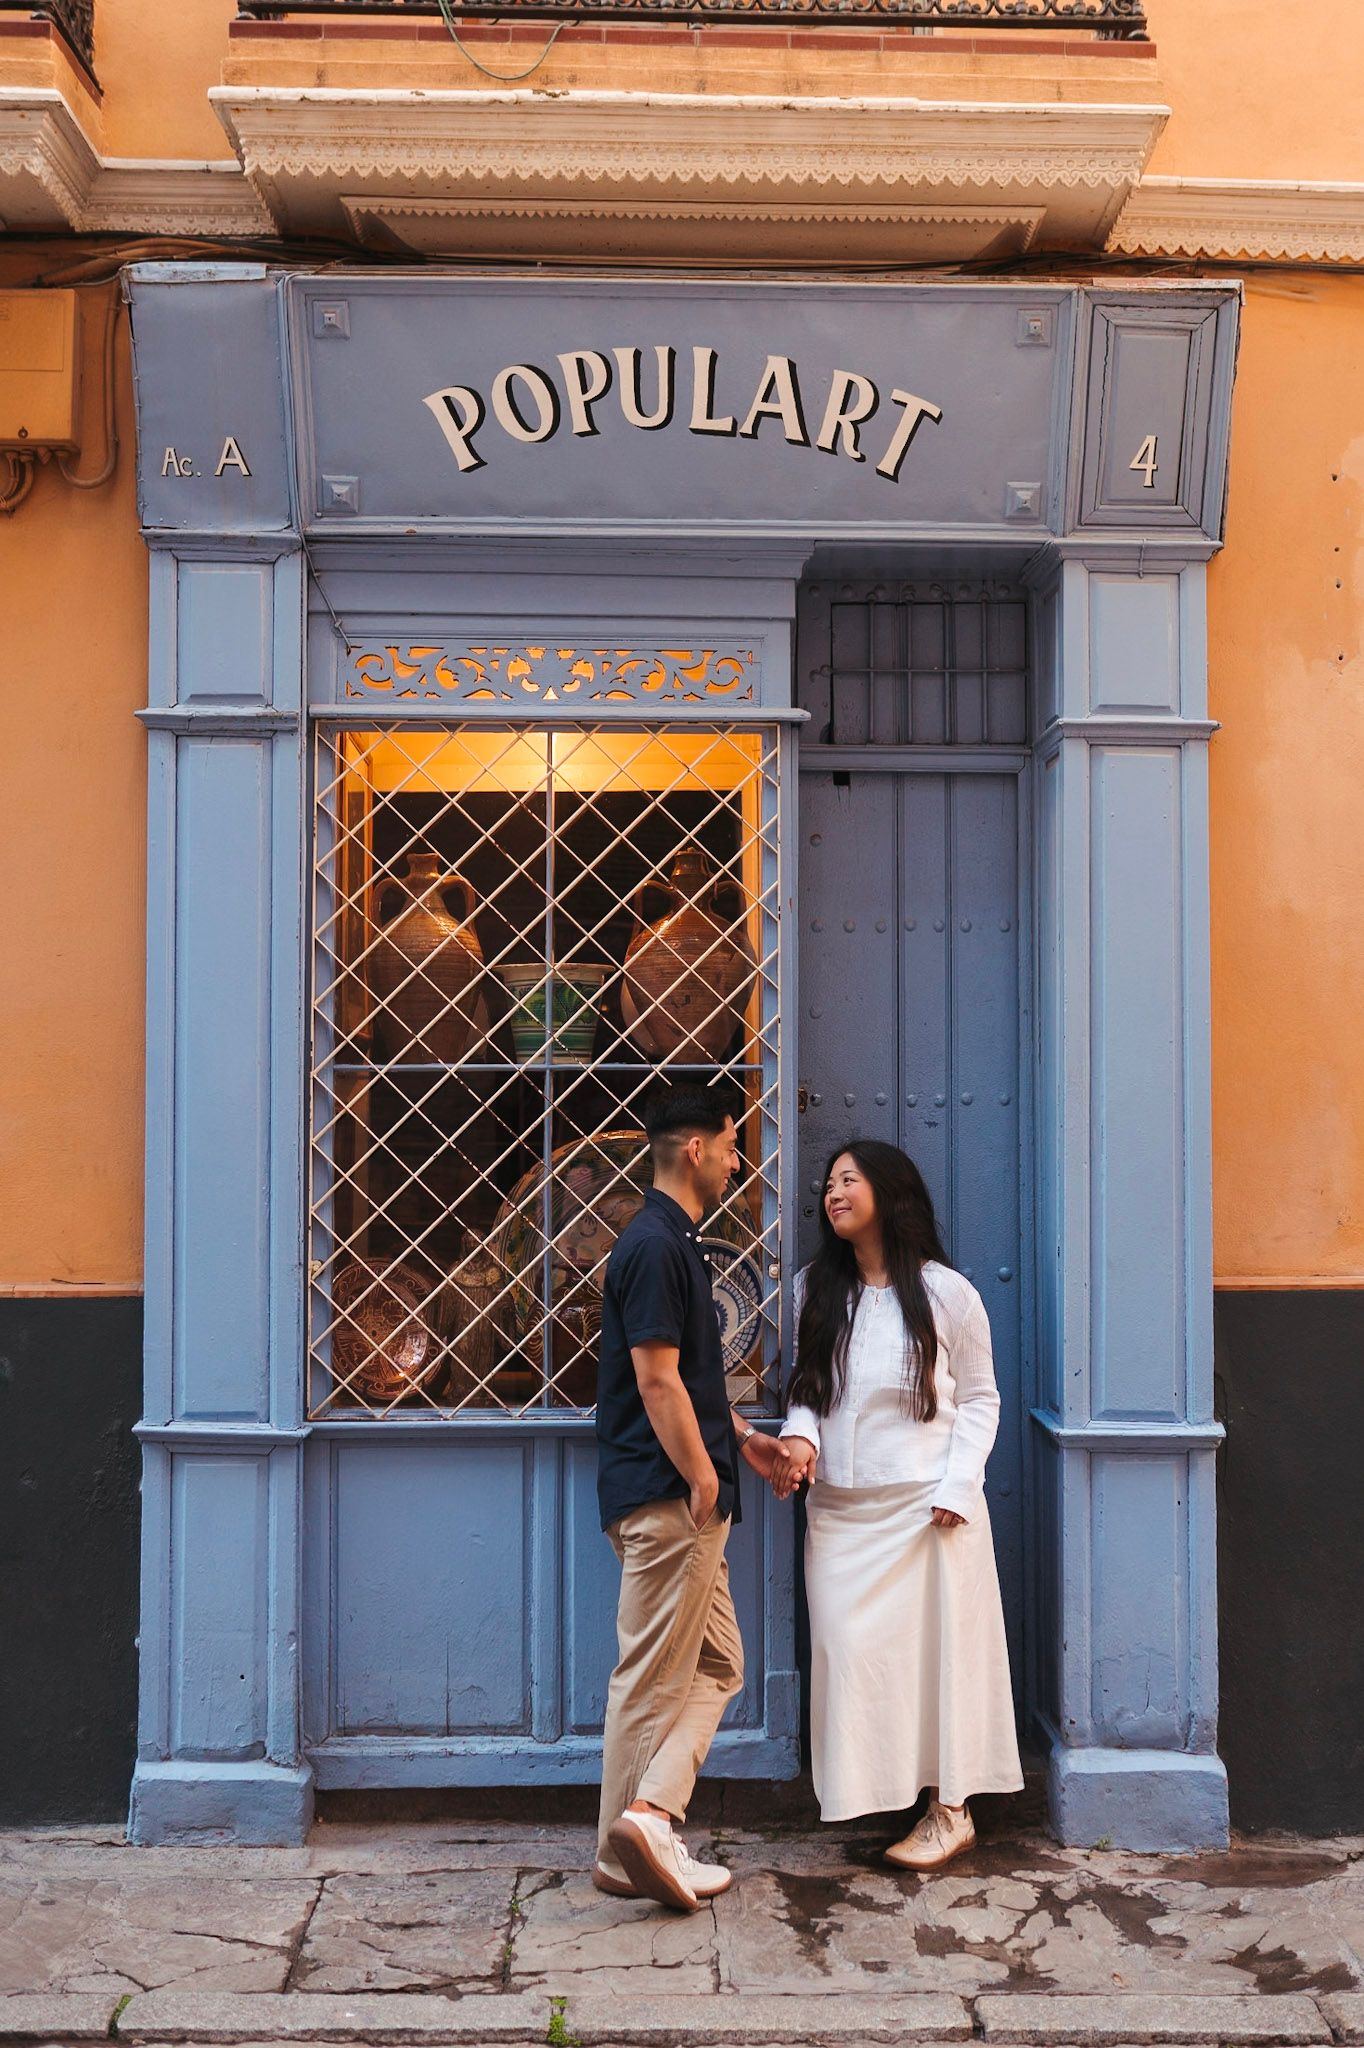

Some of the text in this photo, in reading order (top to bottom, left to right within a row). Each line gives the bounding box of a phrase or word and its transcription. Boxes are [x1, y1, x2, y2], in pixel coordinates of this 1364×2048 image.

[422, 346, 943, 483] POPULART
[161, 436, 252, 477] Ac. A
[1129, 435, 1158, 488] 4
